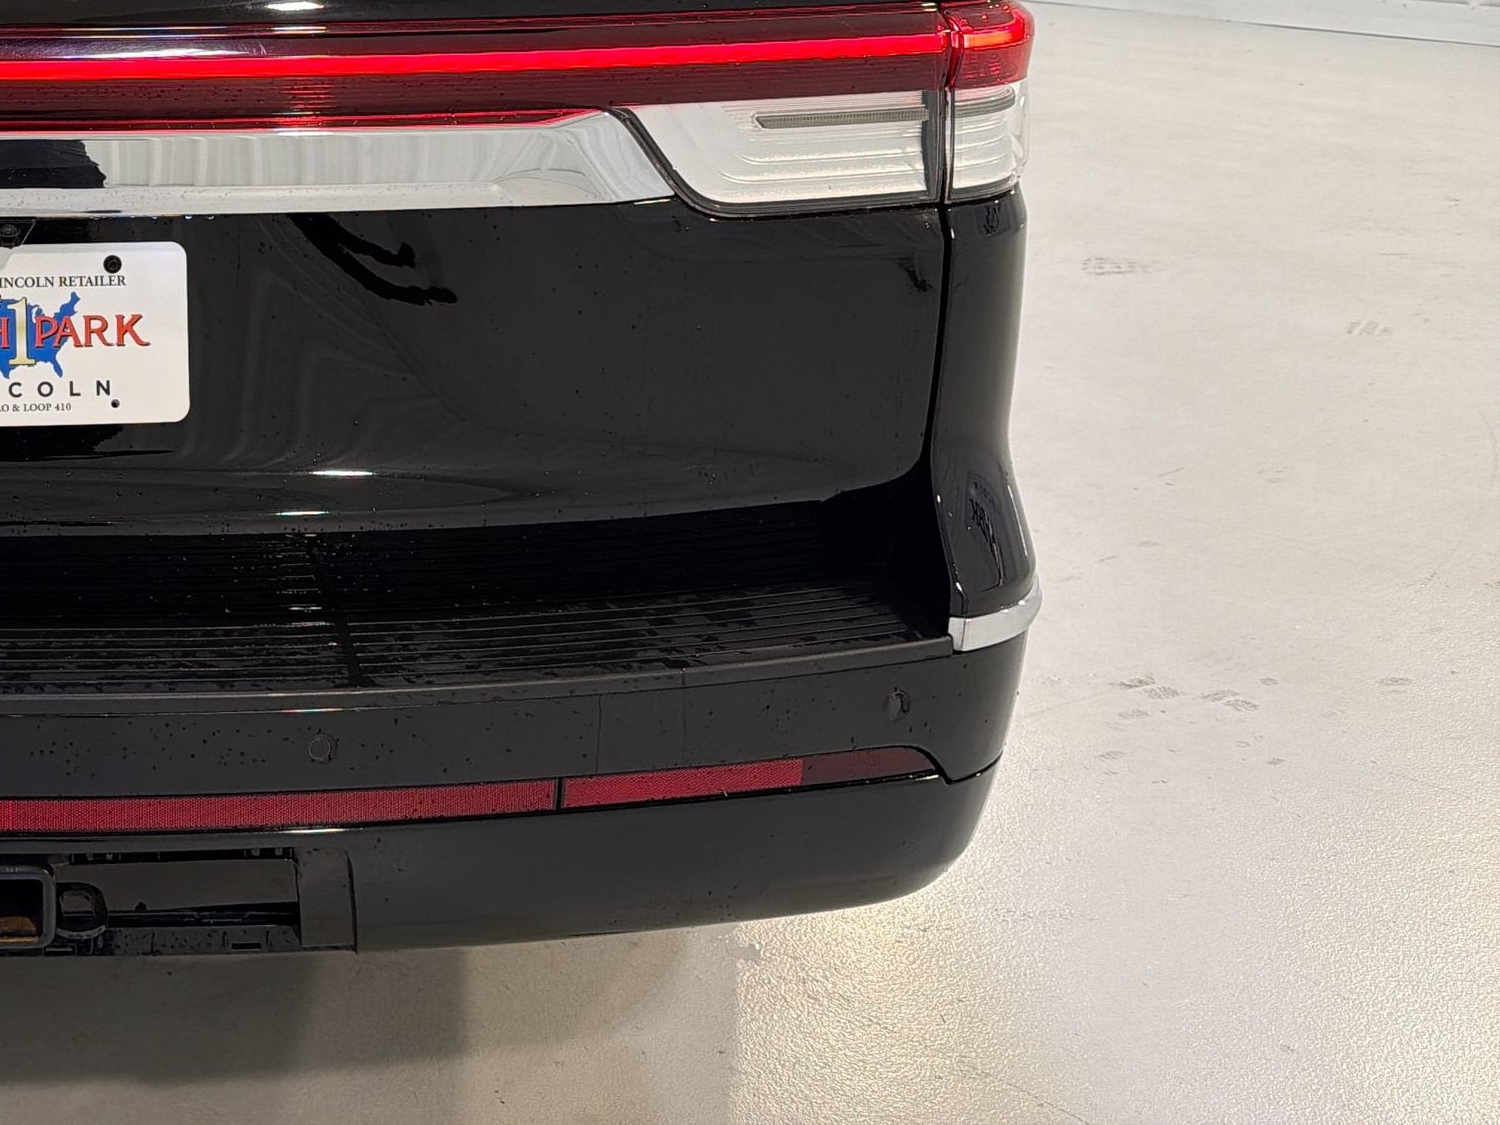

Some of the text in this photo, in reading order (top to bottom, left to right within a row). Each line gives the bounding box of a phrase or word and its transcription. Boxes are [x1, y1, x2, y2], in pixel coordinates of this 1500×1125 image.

[58, 274, 127, 287] RETAILER
[34, 313, 152, 348] PARK
[12, 403, 21, 412] &
[23, 402, 52, 412] LOOP
[54, 402, 72, 412] 410
